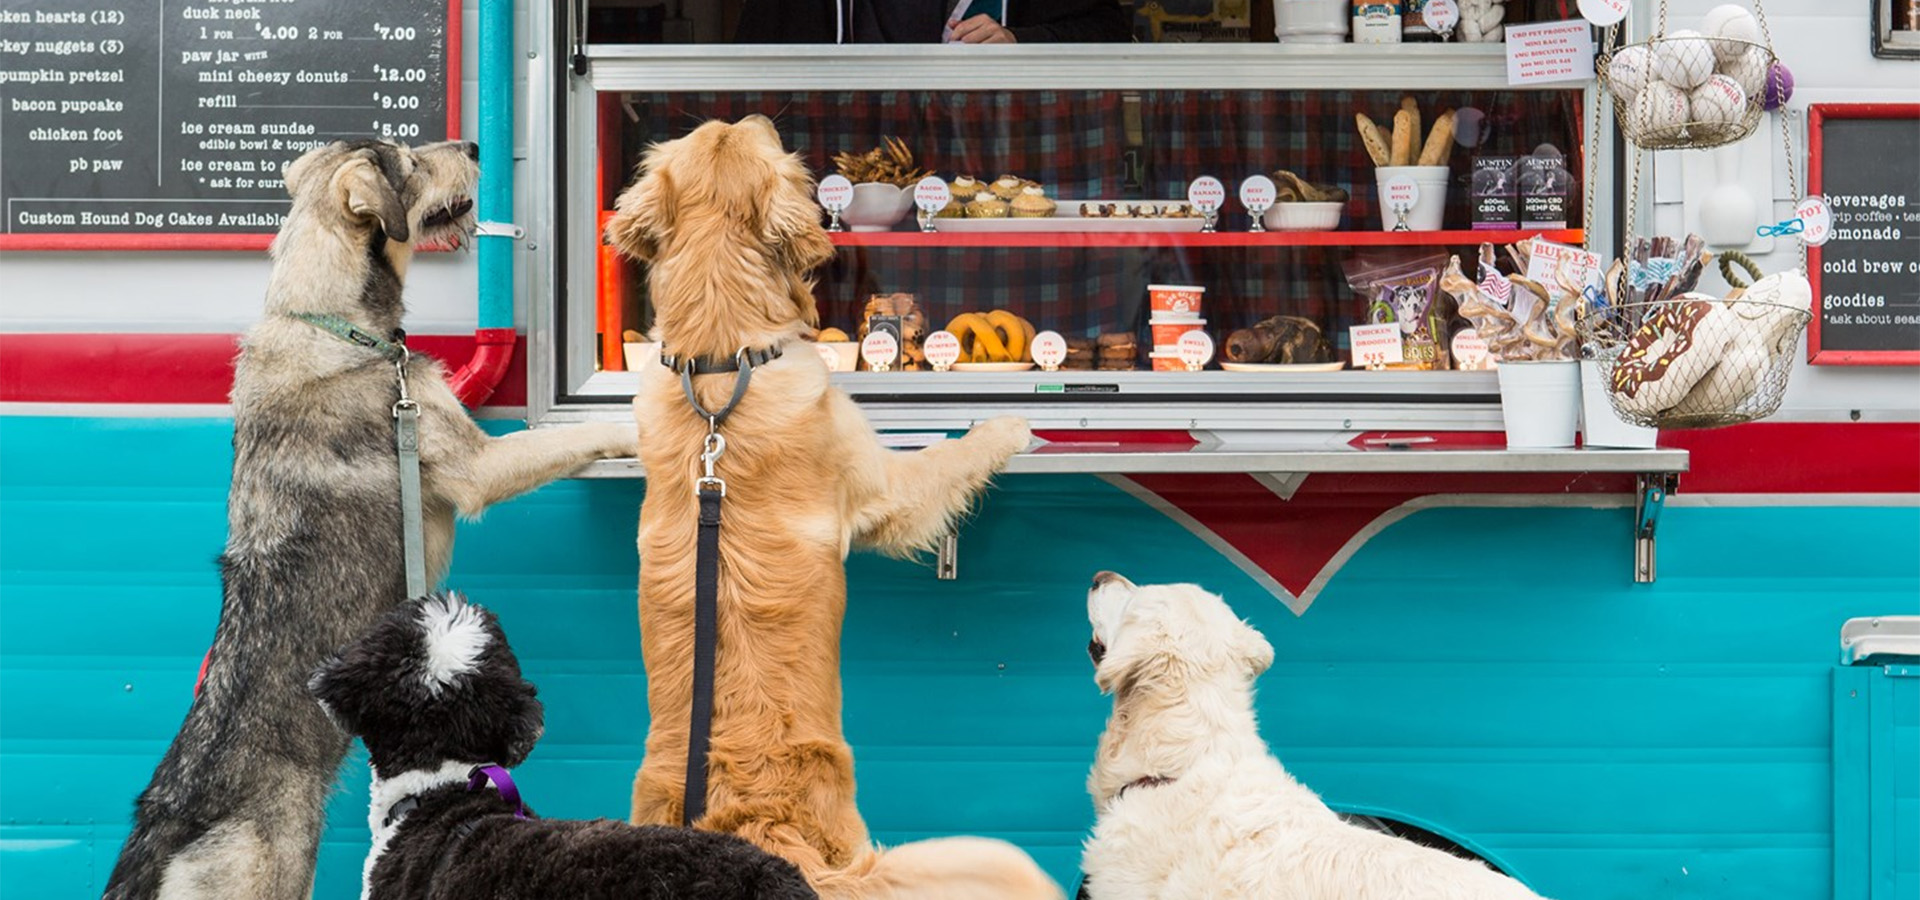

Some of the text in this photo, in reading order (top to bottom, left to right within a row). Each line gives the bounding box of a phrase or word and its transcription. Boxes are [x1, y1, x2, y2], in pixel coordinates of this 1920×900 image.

[36, 10, 86, 23] hearts
[91, 10, 125, 25] (12)
[183, 6, 261, 19] duck neck
[200, 22, 416, 40] 1 FOR $4.00 2 FOR $7.00
[35, 40, 95, 55] nuggets
[100, 40, 124, 55] (3)
[182, 49, 268, 64] paw jar WITH
[0, 69, 124, 84] pumpkin pretzel
[199, 64, 426, 85] mini cheezy donuts $12.00
[12, 98, 124, 114] bacon pupcake
[198, 92, 419, 109] refill $9.00
[29, 128, 123, 140] chicken foot
[181, 120, 420, 137] ice cream sundae $5.00
[200, 140, 331, 152] edible bowl & toppin
[70, 157, 123, 172] pb paw
[181, 158, 203, 172] ice
[208, 160, 255, 172] cream
[260, 160, 276, 172] to
[210, 178, 285, 188] ask for curr
[1823, 193, 1906, 210] beverages
[1798, 204, 1822, 219] TOY
[1833, 212, 1852, 224] rip
[1854, 212, 1892, 222] coffee
[18, 212, 289, 228] Custom Hound Dog Cakes Available
[1804, 226, 1822, 236] $10
[1829, 226, 1901, 240] emonade
[1823, 259, 1920, 273] cold brew c
[1823, 292, 1885, 310] goodies
[1855, 313, 1892, 324] about
[1356, 328, 1392, 336] CHICKEN
[1364, 352, 1384, 361] $15
